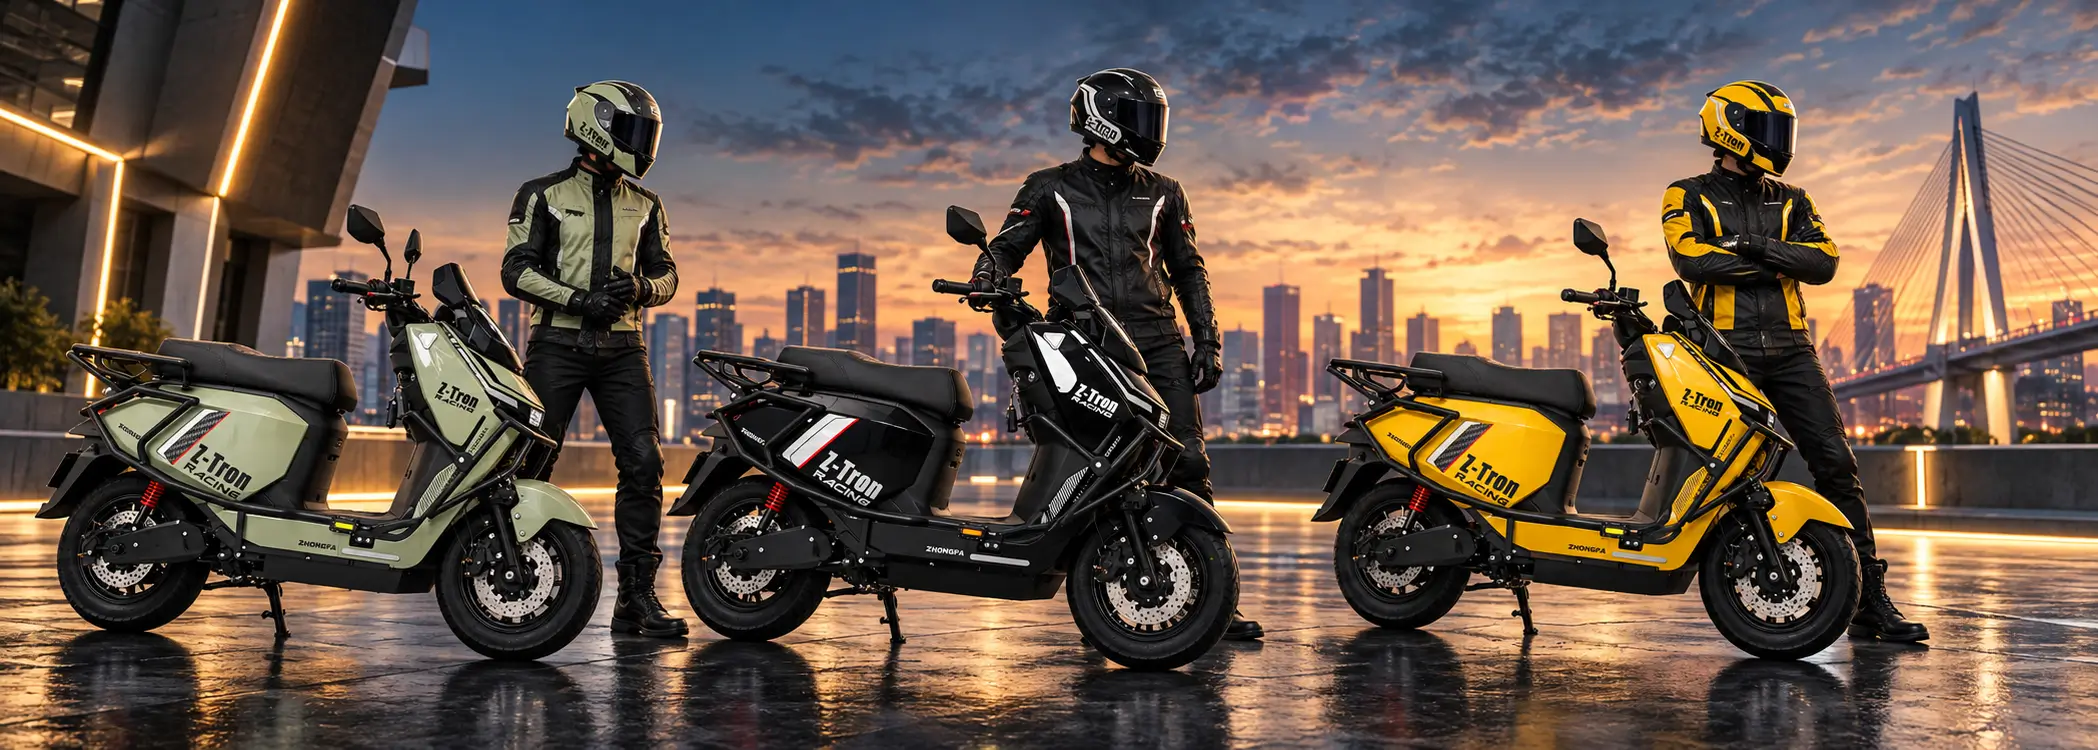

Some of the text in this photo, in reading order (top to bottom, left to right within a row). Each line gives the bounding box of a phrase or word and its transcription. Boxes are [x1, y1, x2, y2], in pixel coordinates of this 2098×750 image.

[434, 394, 475, 414] RACING
[437, 381, 479, 408] Z-Tron
[1071, 396, 1113, 419] RACING
[1074, 383, 1119, 413] Z-Tron
[1680, 400, 1720, 417] RACING
[1682, 388, 1723, 411] Z-Tron
[183, 462, 242, 499] RACING
[190, 443, 252, 491] Z-Tron
[818, 450, 883, 499] Z-Tron
[1459, 453, 1520, 498] Z-Tron
[812, 469, 871, 507] RACING
[1454, 471, 1510, 507] RACING
